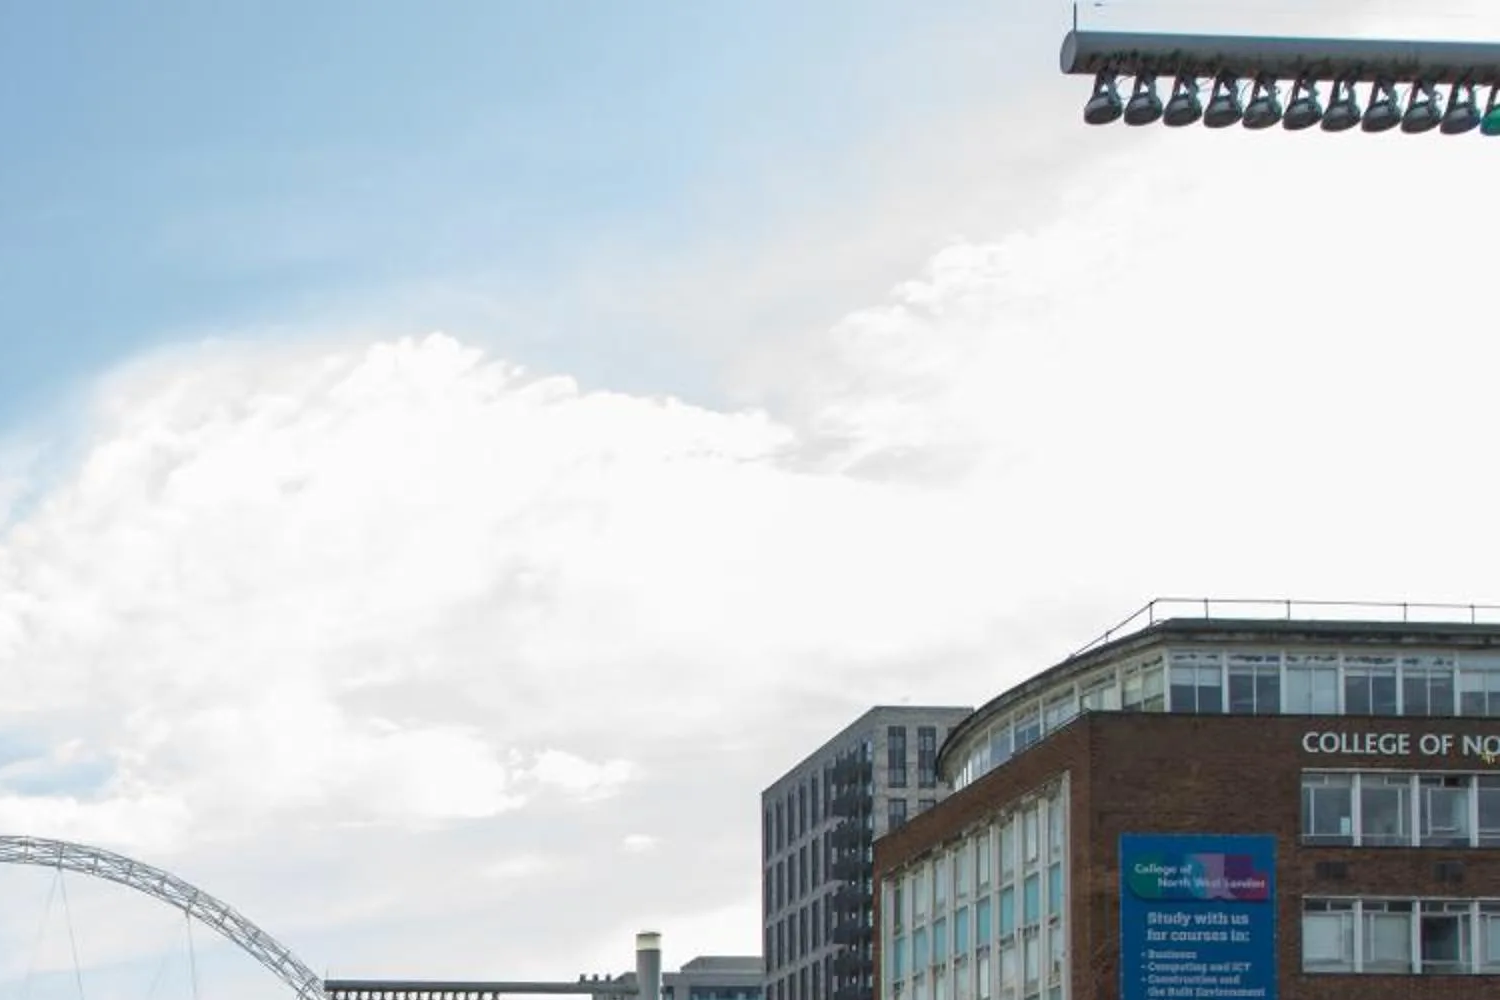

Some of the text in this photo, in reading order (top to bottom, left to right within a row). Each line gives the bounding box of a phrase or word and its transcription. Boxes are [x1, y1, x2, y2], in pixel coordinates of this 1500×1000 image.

[1302, 731, 1500, 756] COLLEGE OF NO
[1134, 863, 1193, 875] College of
[1157, 877, 1191, 888] North
[1147, 912, 1249, 926] Study with us
[1147, 928, 1167, 941] for
[1170, 930, 1227, 941] courses
